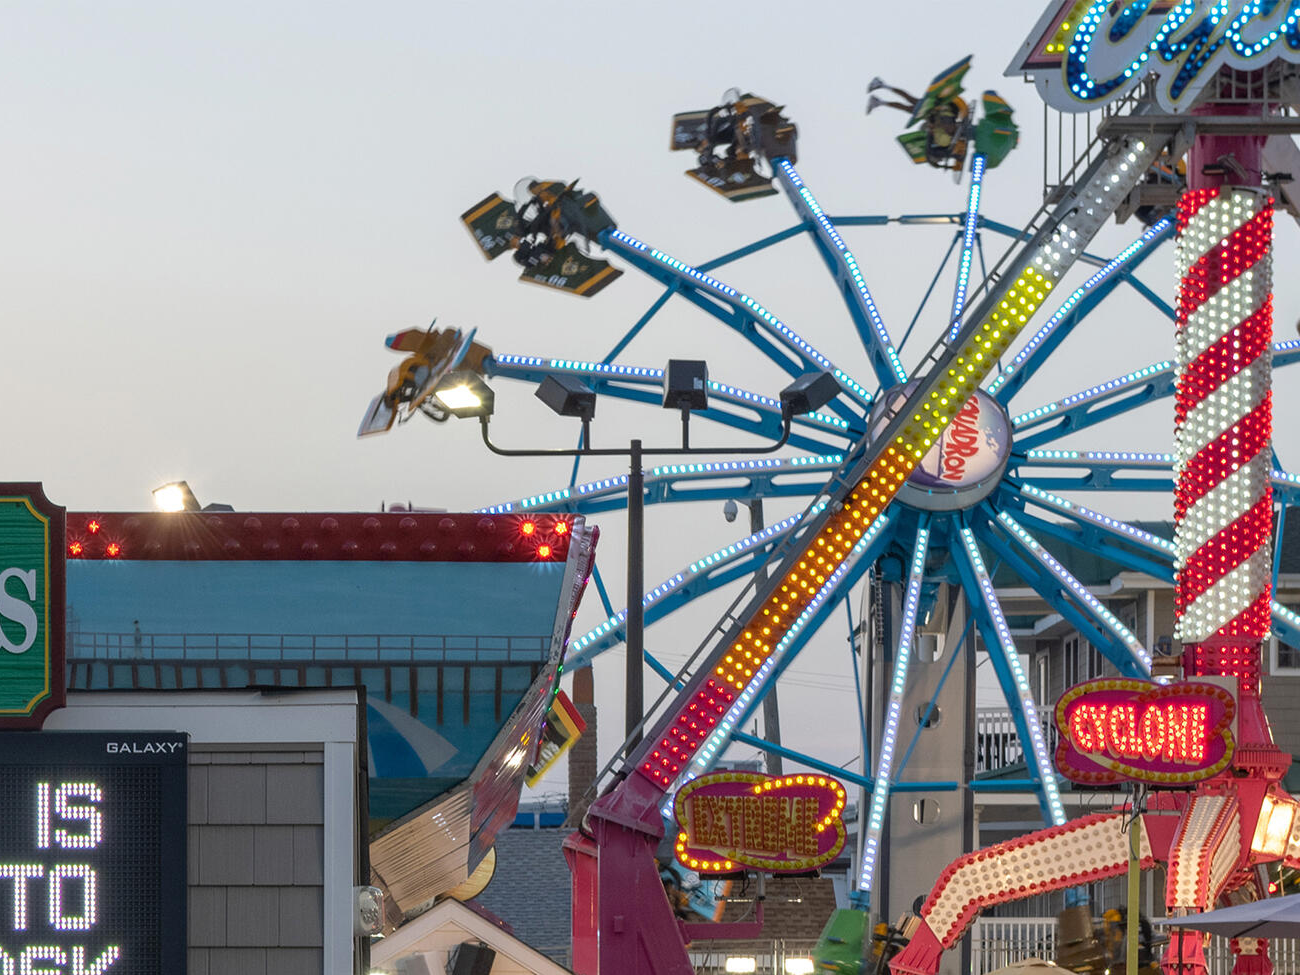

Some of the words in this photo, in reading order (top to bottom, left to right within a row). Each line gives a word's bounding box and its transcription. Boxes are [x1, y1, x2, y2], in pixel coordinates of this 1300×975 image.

[1069, 703, 1207, 765] CYCLONE
[37, 782, 103, 849] IS
[686, 794, 820, 858] EXTREME
